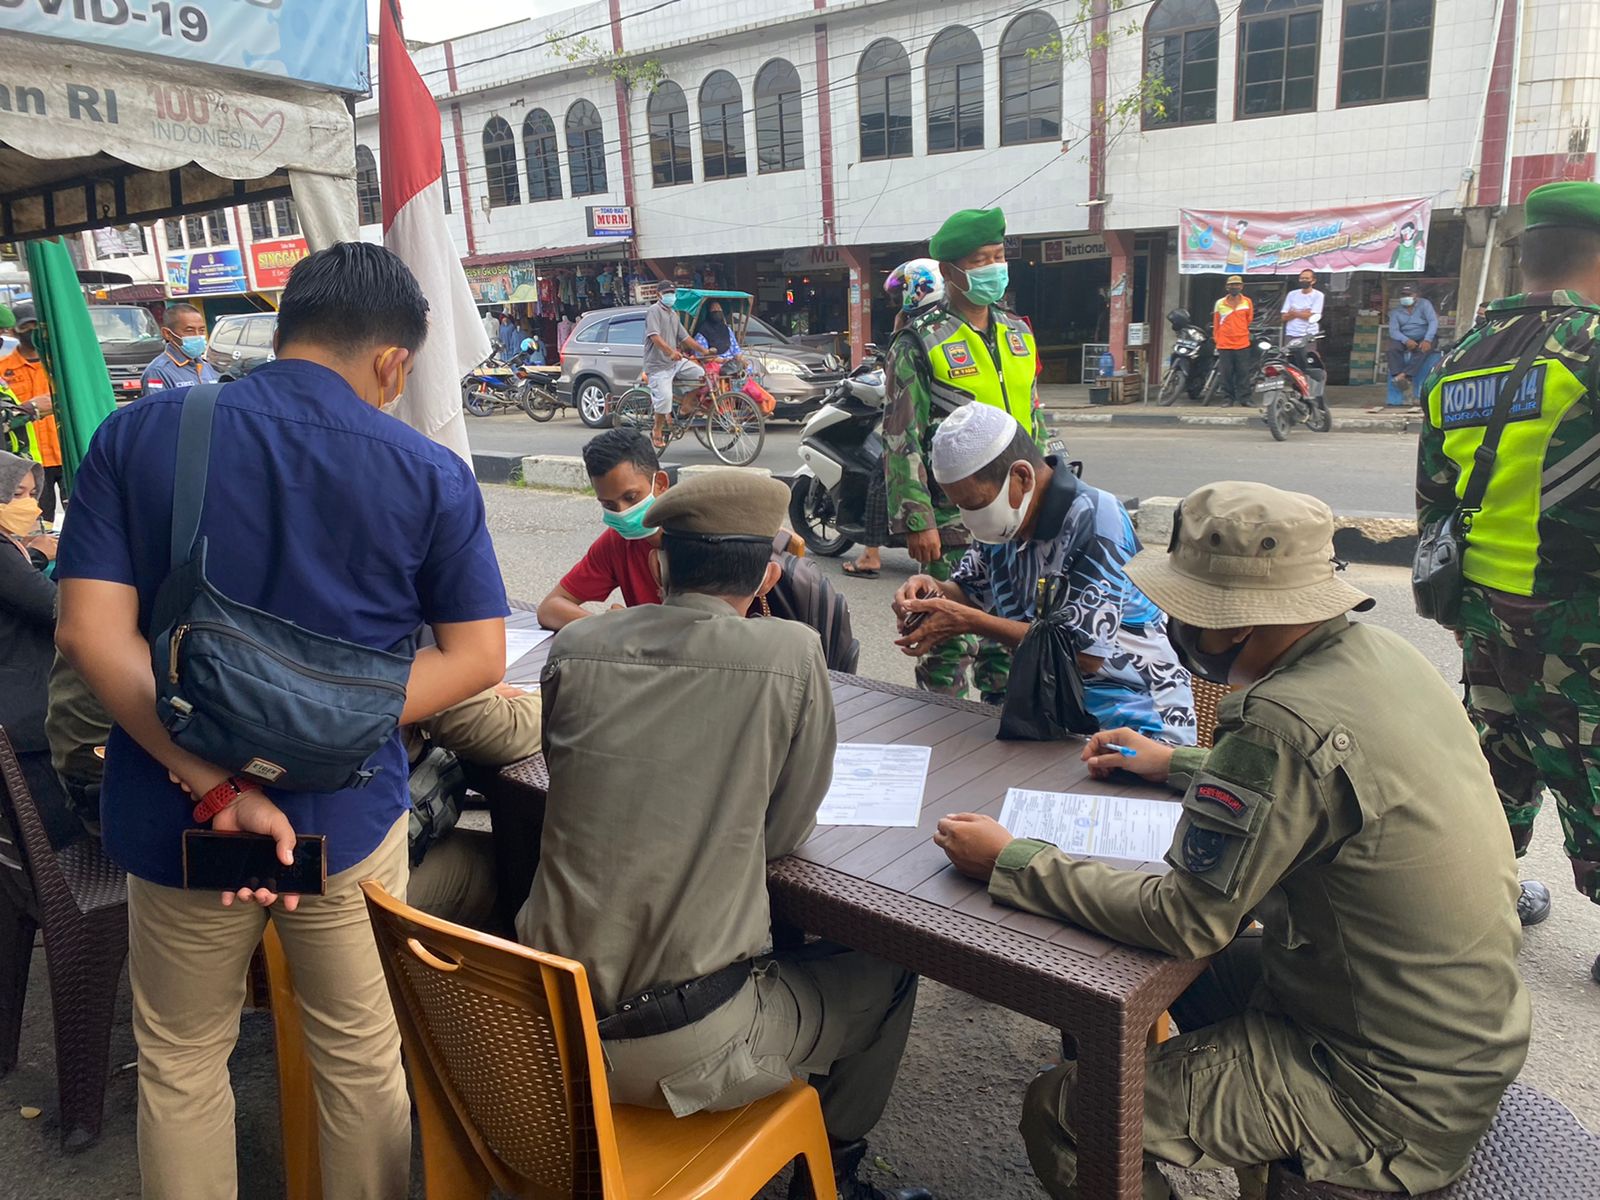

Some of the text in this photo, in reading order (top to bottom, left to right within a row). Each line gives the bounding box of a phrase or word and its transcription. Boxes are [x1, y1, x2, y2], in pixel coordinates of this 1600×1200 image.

[66, 83, 119, 124] RI
[151, 121, 261, 152] INDONESIA
[597, 214, 628, 225] MURNI
[1065, 241, 1107, 256] National
[1279, 233, 1348, 264] Indonesia
[1444, 368, 1538, 413] KODIM 14
